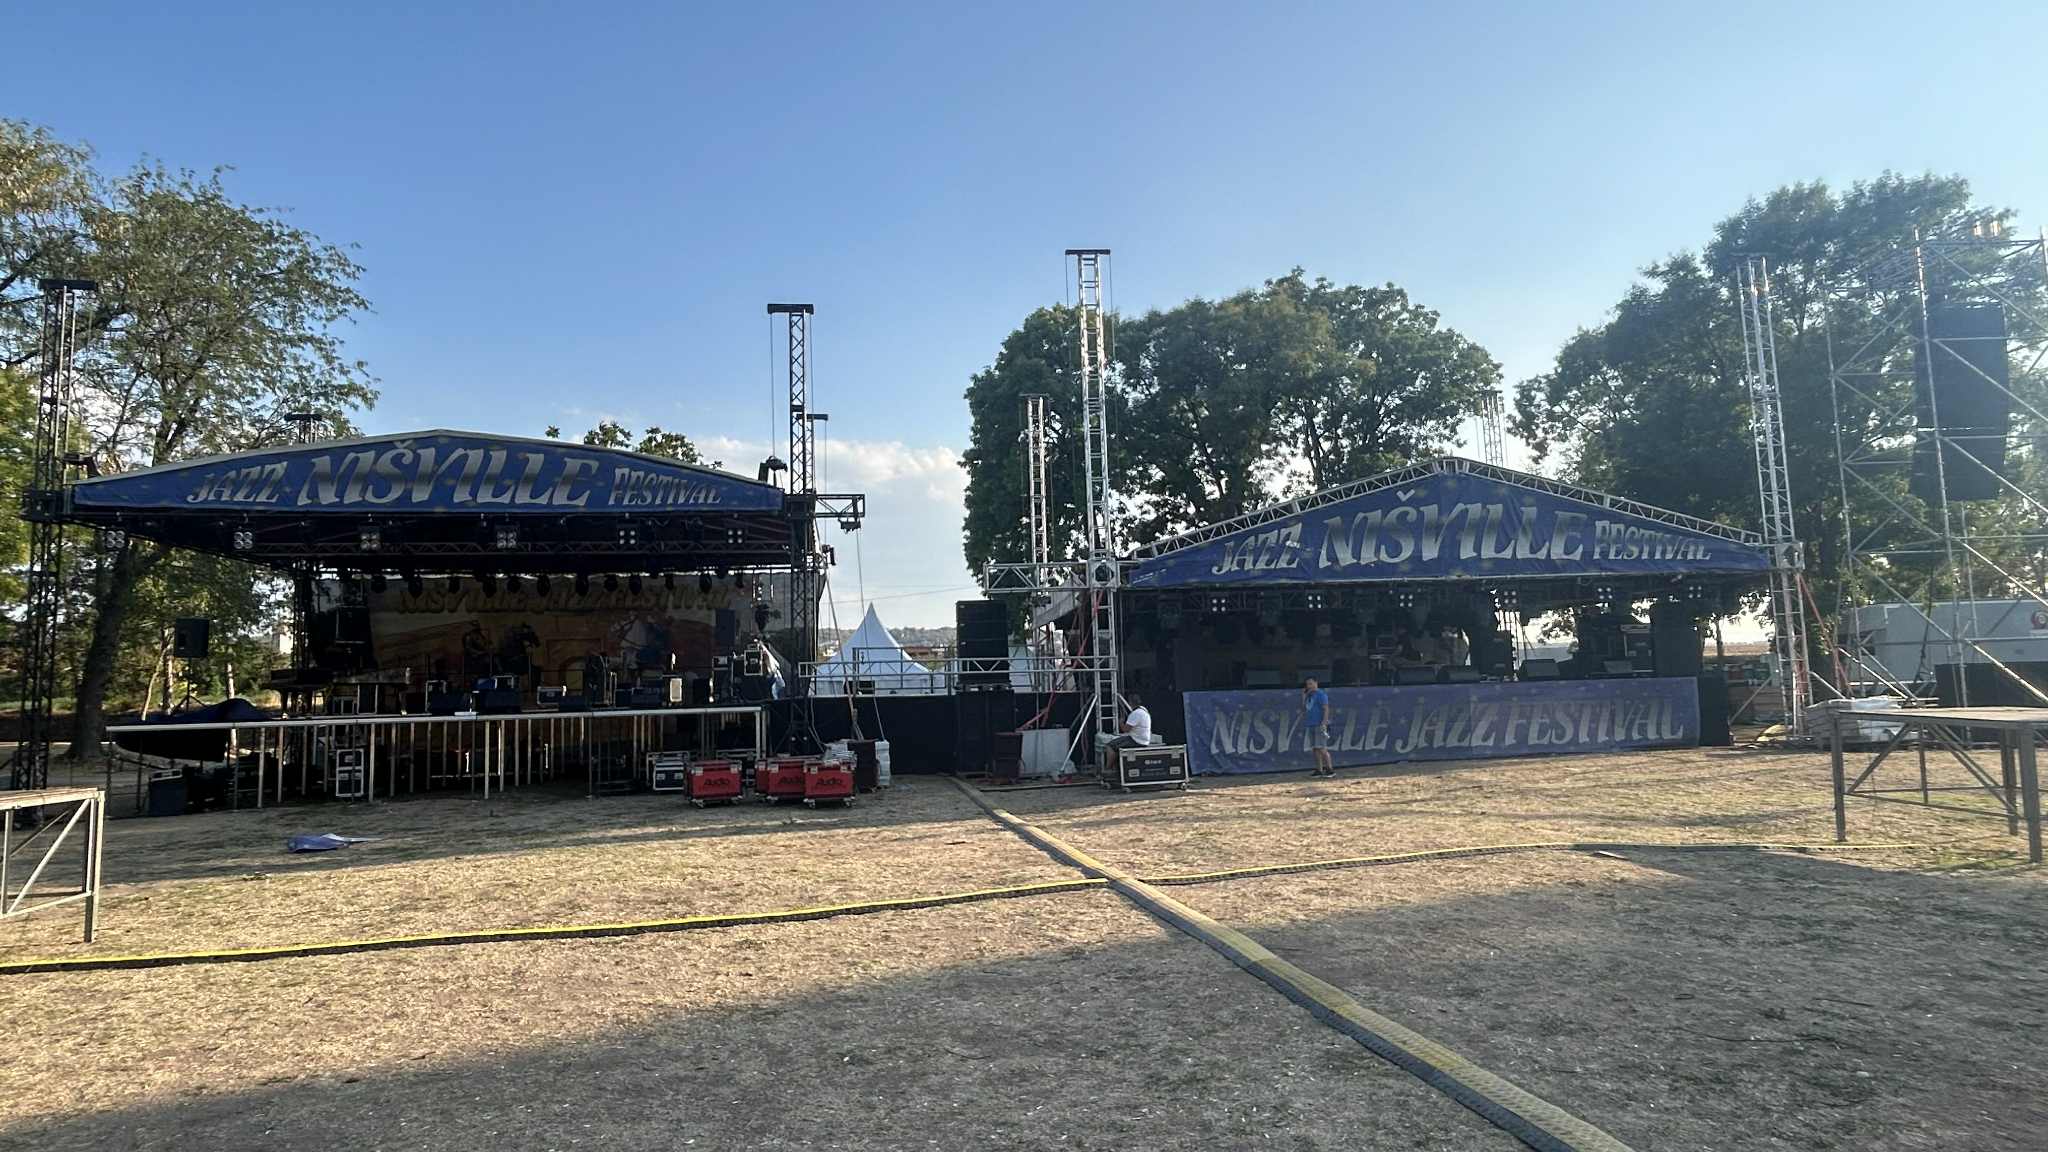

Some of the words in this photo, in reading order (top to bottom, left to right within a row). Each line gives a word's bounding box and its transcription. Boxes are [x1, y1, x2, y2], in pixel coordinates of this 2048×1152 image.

[187, 461, 288, 504] JAZZ
[297, 439, 599, 506] NIŠVILLE
[608, 467, 721, 506] FESTIVAL
[1212, 522, 1303, 575] JAZZ
[1319, 489, 1588, 569] NIŠVILLE
[1593, 520, 1711, 561] FESTIVAL
[1395, 698, 1498, 753] JAZZ
[1505, 698, 1684, 746] FESTIVAL
